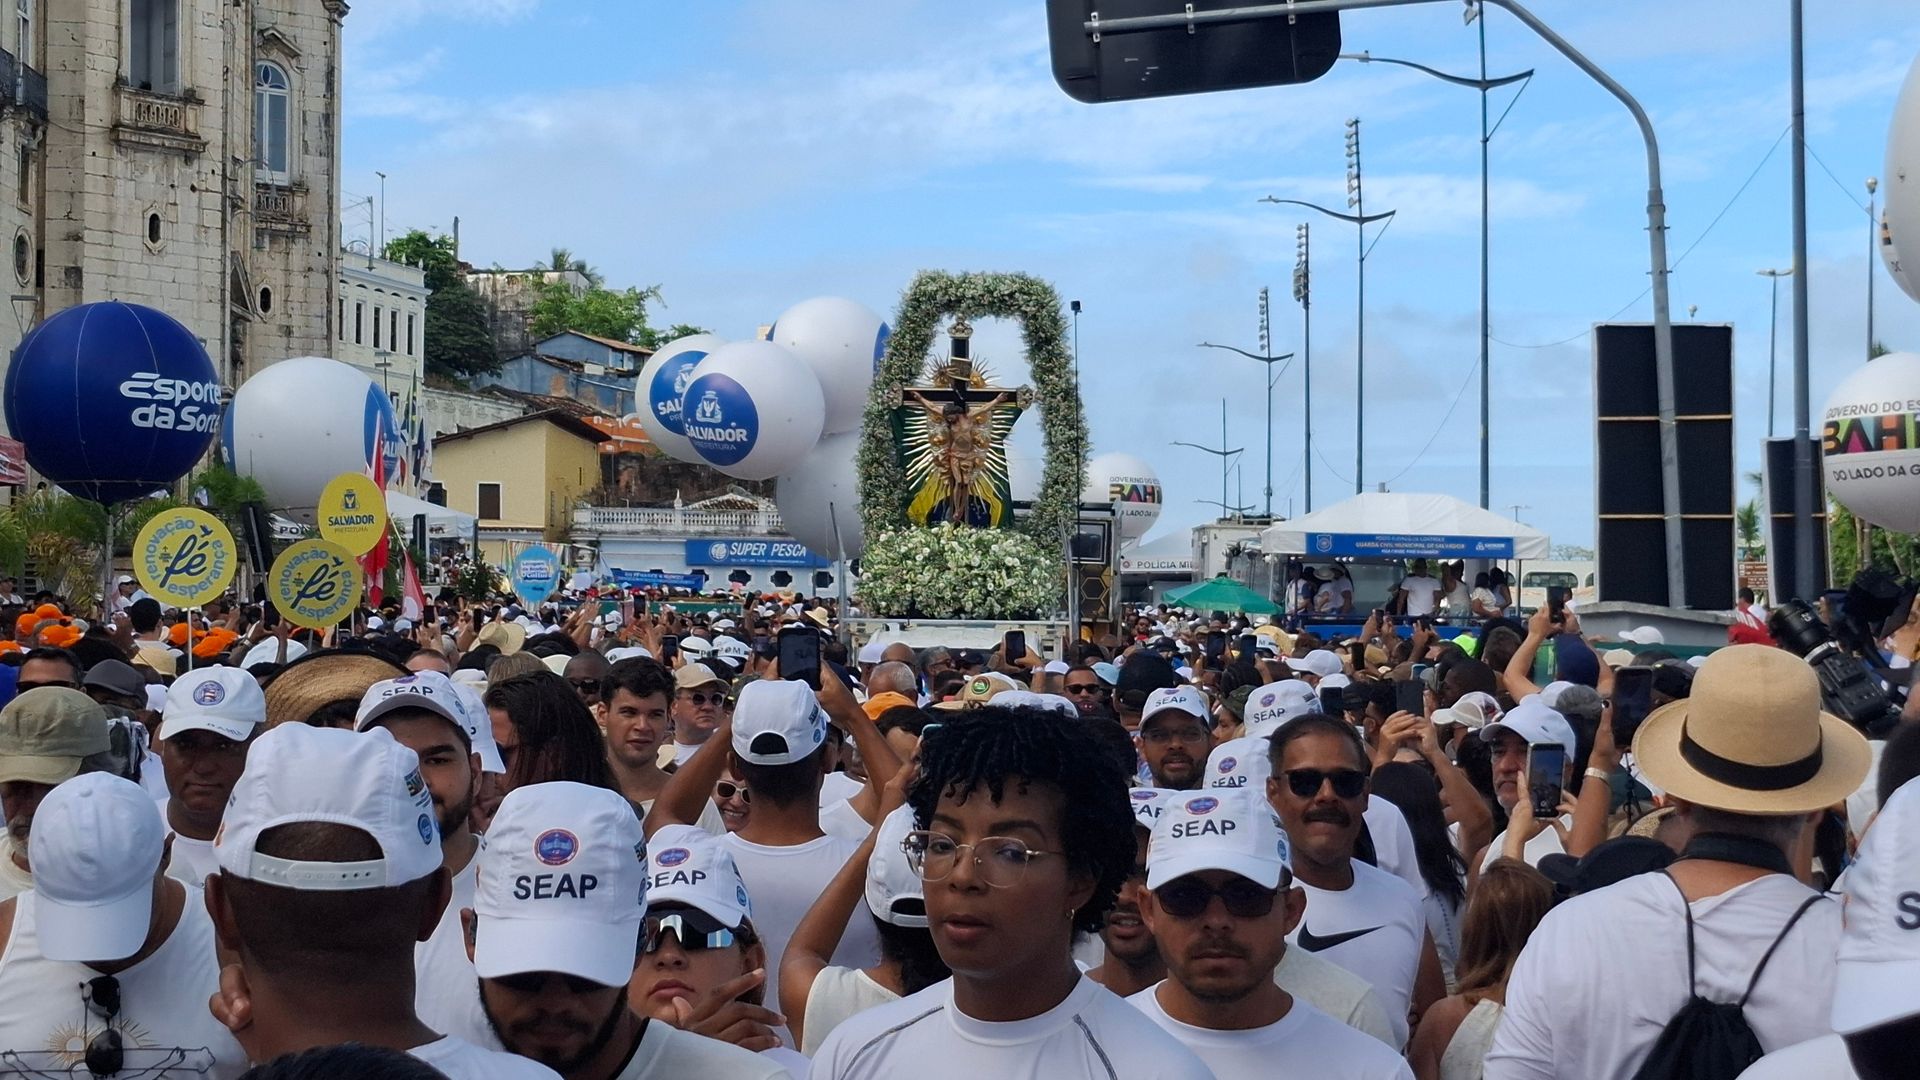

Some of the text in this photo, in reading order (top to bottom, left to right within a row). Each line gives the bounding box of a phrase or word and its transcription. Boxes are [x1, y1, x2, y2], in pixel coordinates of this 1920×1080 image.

[120, 372, 221, 407] Esporte
[131, 403, 175, 429] da
[658, 398, 682, 415] SAL
[1826, 403, 1878, 418] GOVERNO
[1882, 402, 1902, 412] DO
[685, 423, 748, 442] SALVADOR
[1849, 466, 1884, 480] LADO
[1888, 465, 1906, 477] DA
[328, 514, 375, 527] SALVADOR
[145, 515, 195, 581] renovação
[729, 542, 806, 557] SUPER PESCA
[159, 534, 209, 589] fé
[168, 540, 229, 600] esperança
[280, 545, 329, 602] renovação
[289, 563, 340, 610] fé
[297, 570, 356, 622] esperança
[1253, 707, 1286, 724] SEAP
[1171, 819, 1237, 839] SEAP
[513, 873, 598, 900] SEAP
